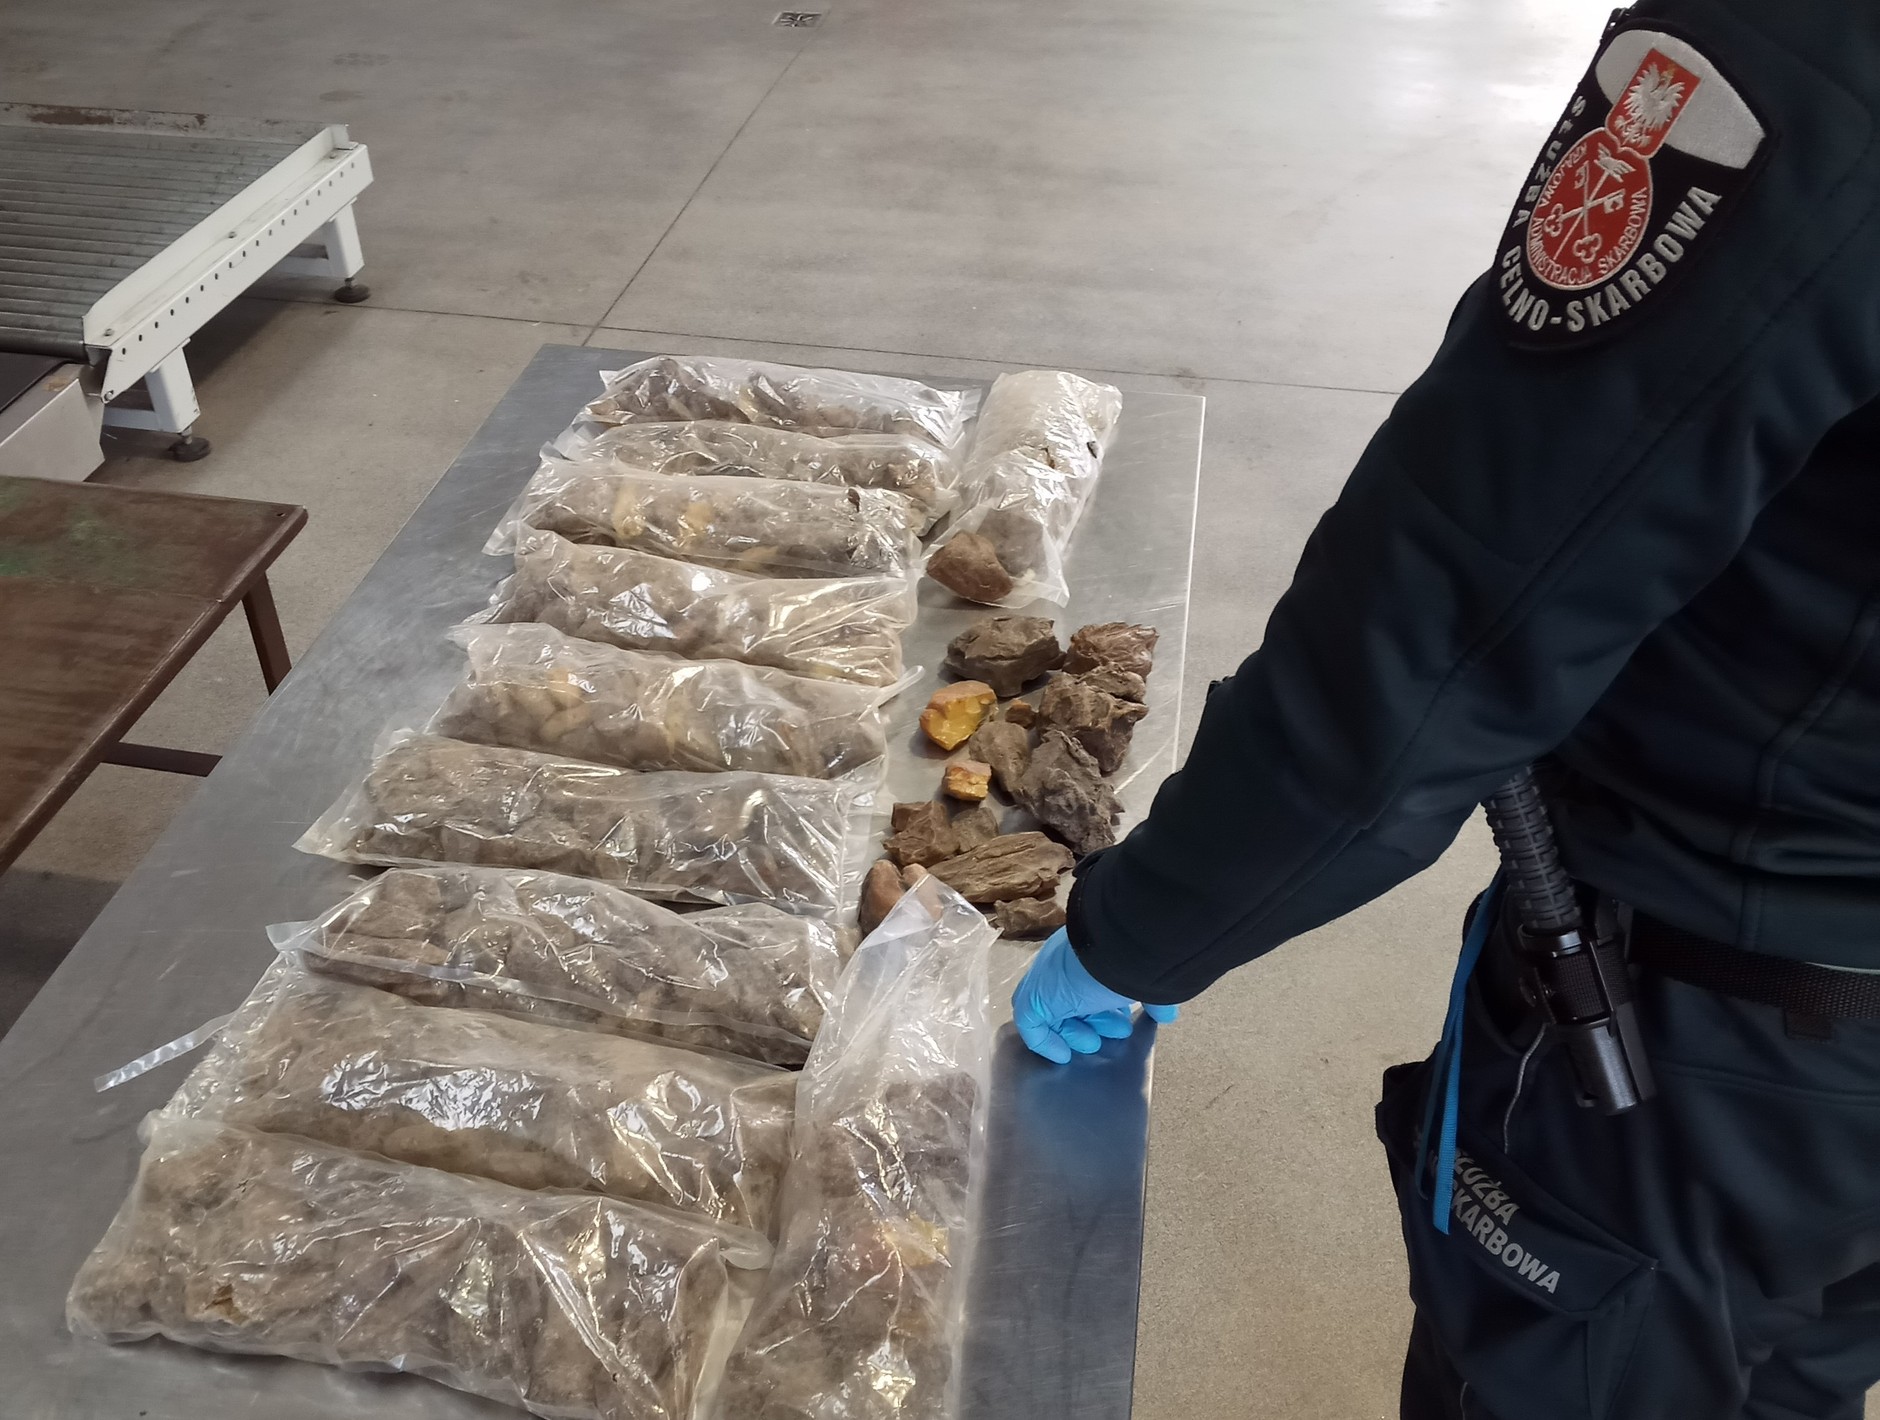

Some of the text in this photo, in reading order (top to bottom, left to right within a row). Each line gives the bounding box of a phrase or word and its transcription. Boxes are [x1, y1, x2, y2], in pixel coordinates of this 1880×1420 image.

[1501, 186, 1722, 333] CELNO-SKARBOWA
[1530, 216, 1593, 286] ADMINISTRACJA
[1598, 186, 1648, 275] SKARBOWA
[1452, 1180, 1561, 1294] KARBOWA
